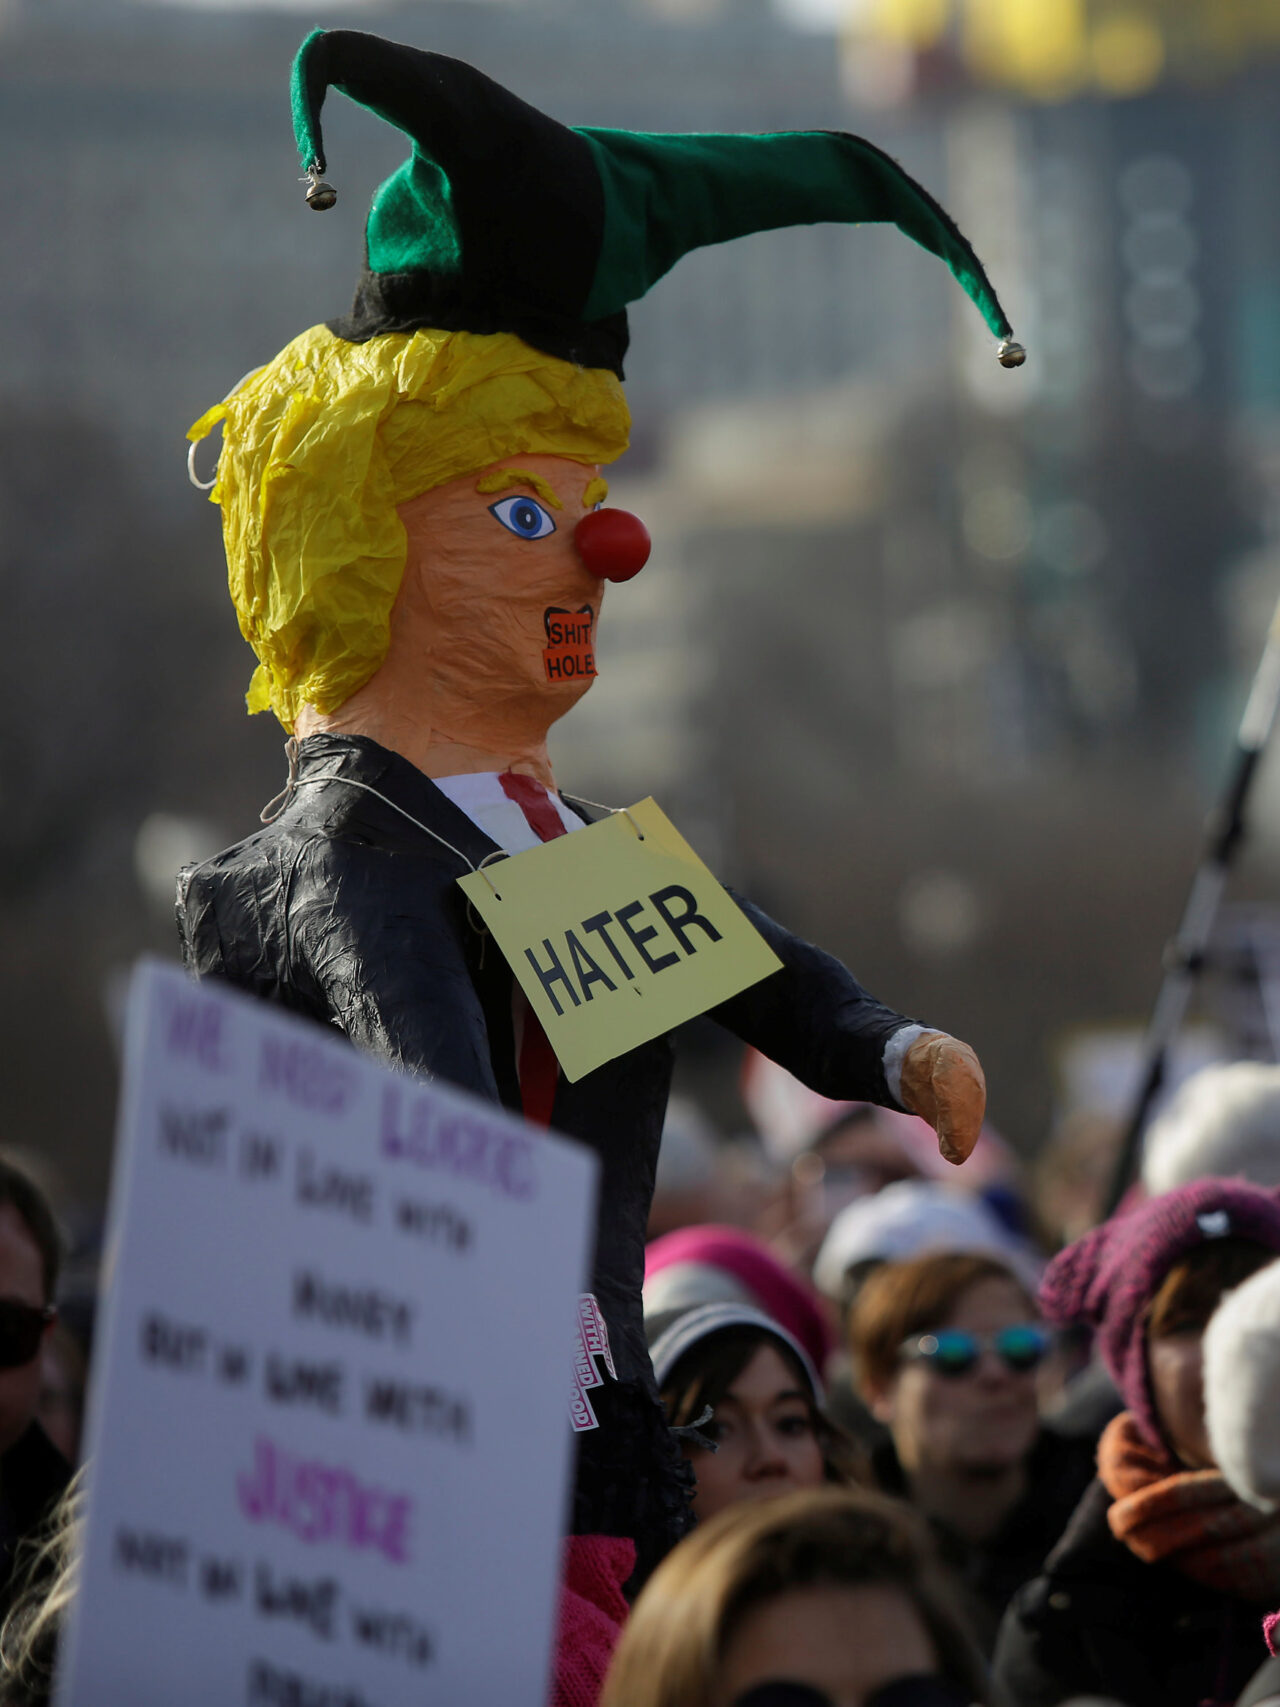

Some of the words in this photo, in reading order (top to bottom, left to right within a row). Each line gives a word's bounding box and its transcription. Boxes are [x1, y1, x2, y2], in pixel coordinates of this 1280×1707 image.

[551, 622, 591, 645] SHIT
[547, 653, 594, 679] HOLE
[524, 884, 723, 1016] HATER
[141, 1310, 206, 1374] BUT
[580, 1300, 602, 1350] WITH
